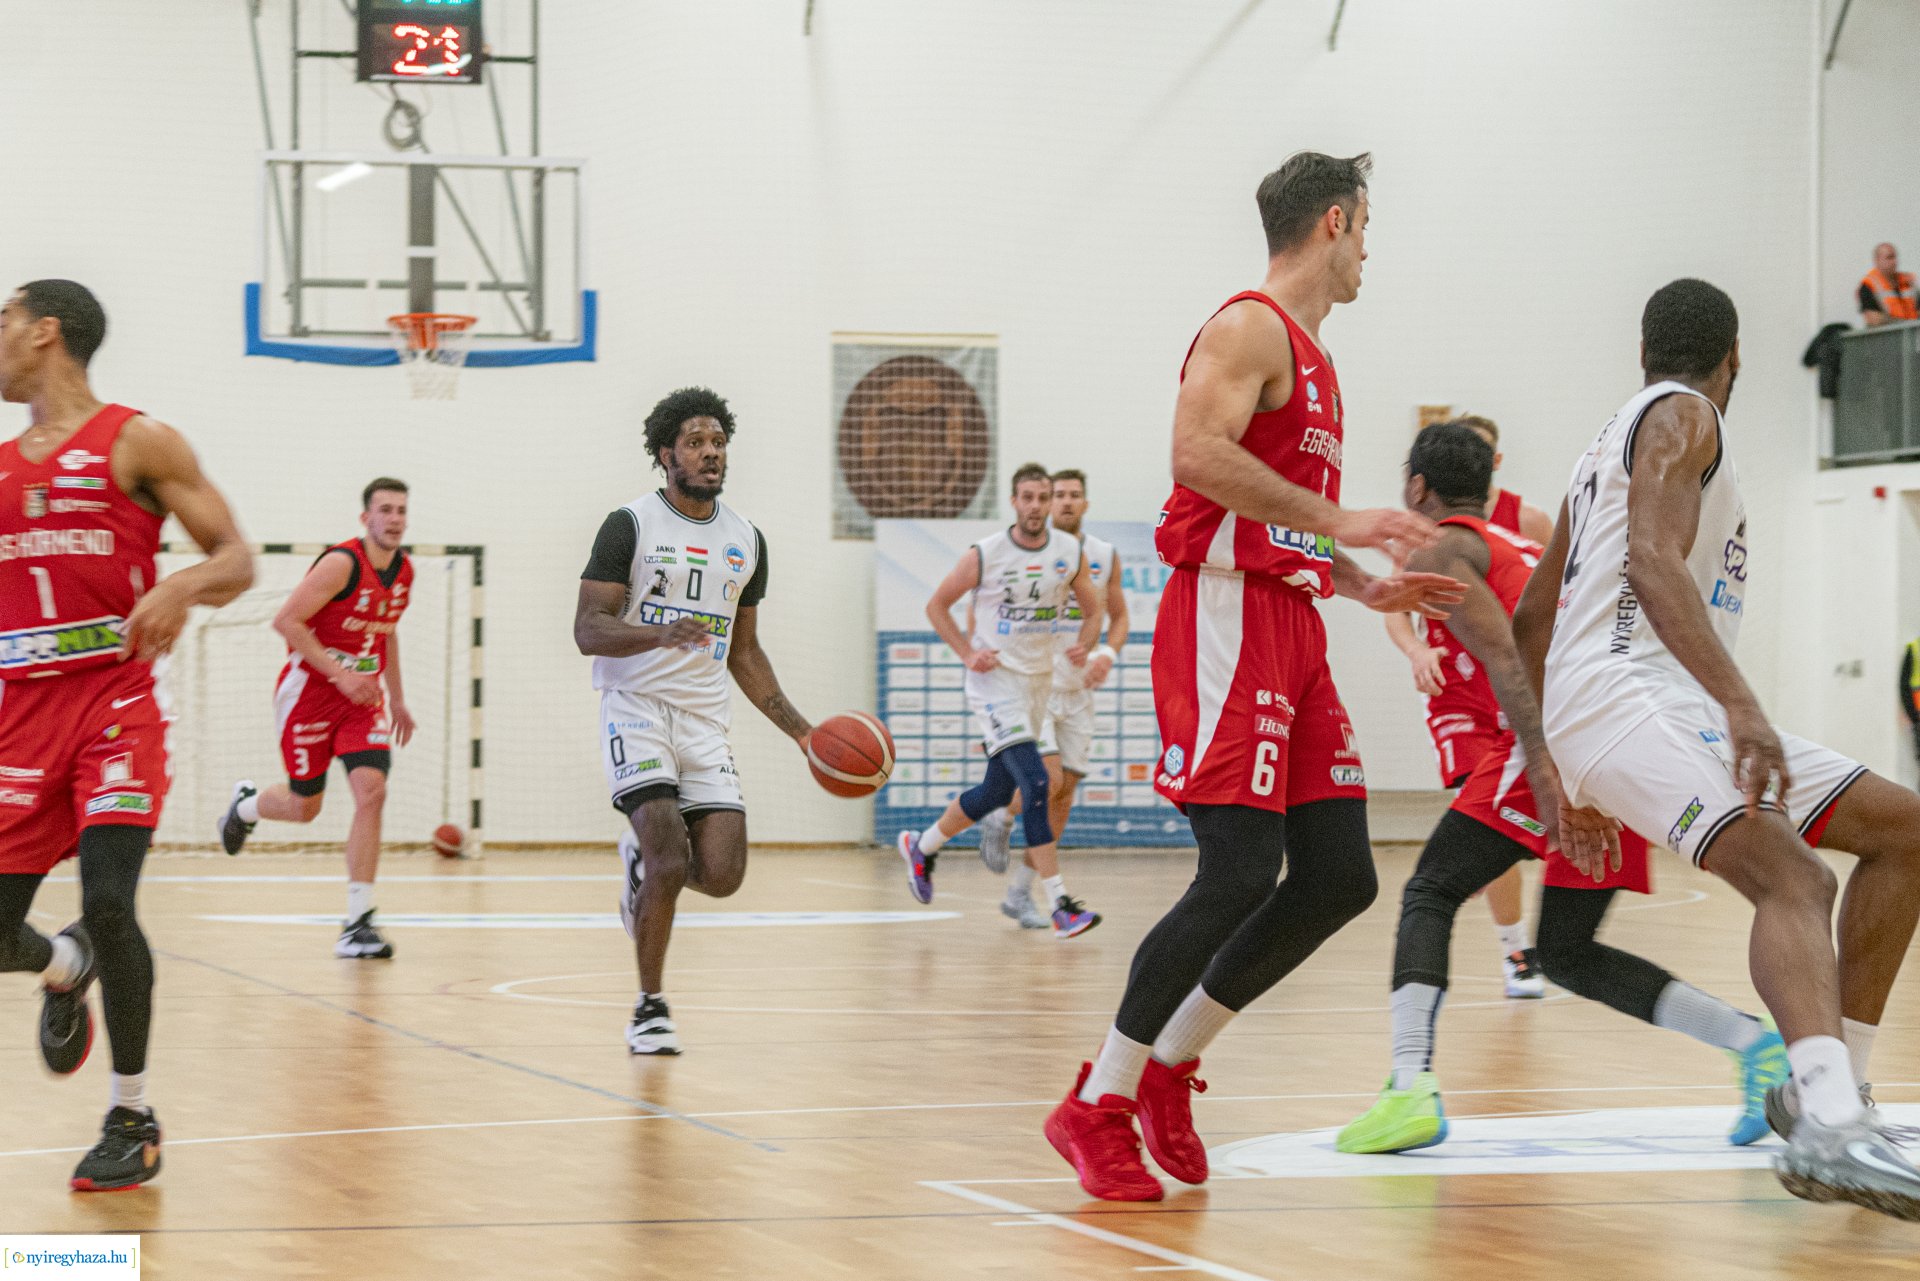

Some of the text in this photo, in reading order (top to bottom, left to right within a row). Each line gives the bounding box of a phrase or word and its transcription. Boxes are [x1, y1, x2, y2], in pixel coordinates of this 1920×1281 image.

[656, 545, 676, 554] JAKO
[28, 566, 58, 619] 1
[1028, 580, 1041, 601] 4
[294, 748, 310, 775] 3
[1251, 740, 1278, 796] 6
